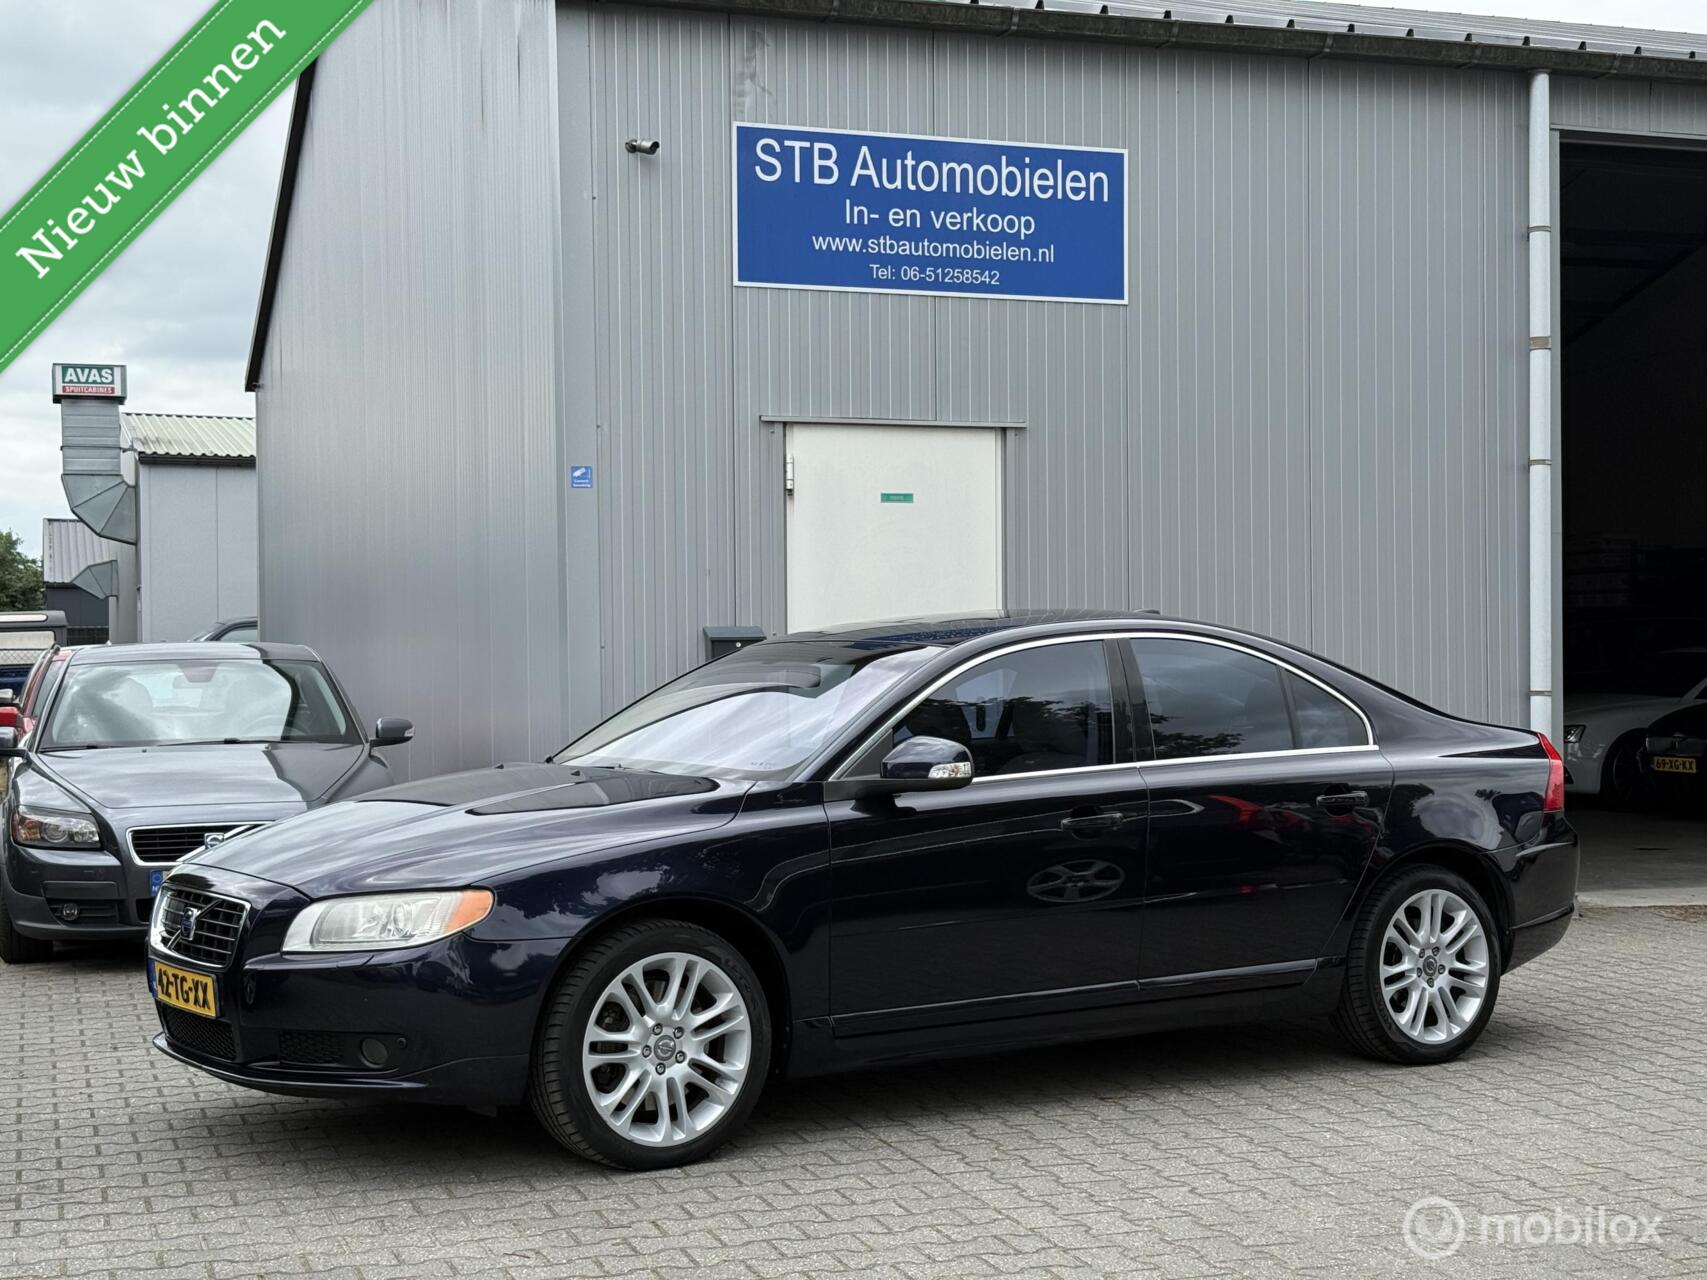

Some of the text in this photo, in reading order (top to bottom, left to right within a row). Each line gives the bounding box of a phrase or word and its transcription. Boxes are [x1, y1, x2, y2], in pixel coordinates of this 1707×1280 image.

[755, 138, 1109, 202] STB Automobielen
[846, 199, 1035, 240] In- en verkoop
[812, 235, 1054, 263] www.stbautomobielen.nl
[869, 264, 1000, 285] Tel: 06-51258542
[64, 368, 113, 383] AVAS
[158, 968, 211, 1010] 42-TG-XX
